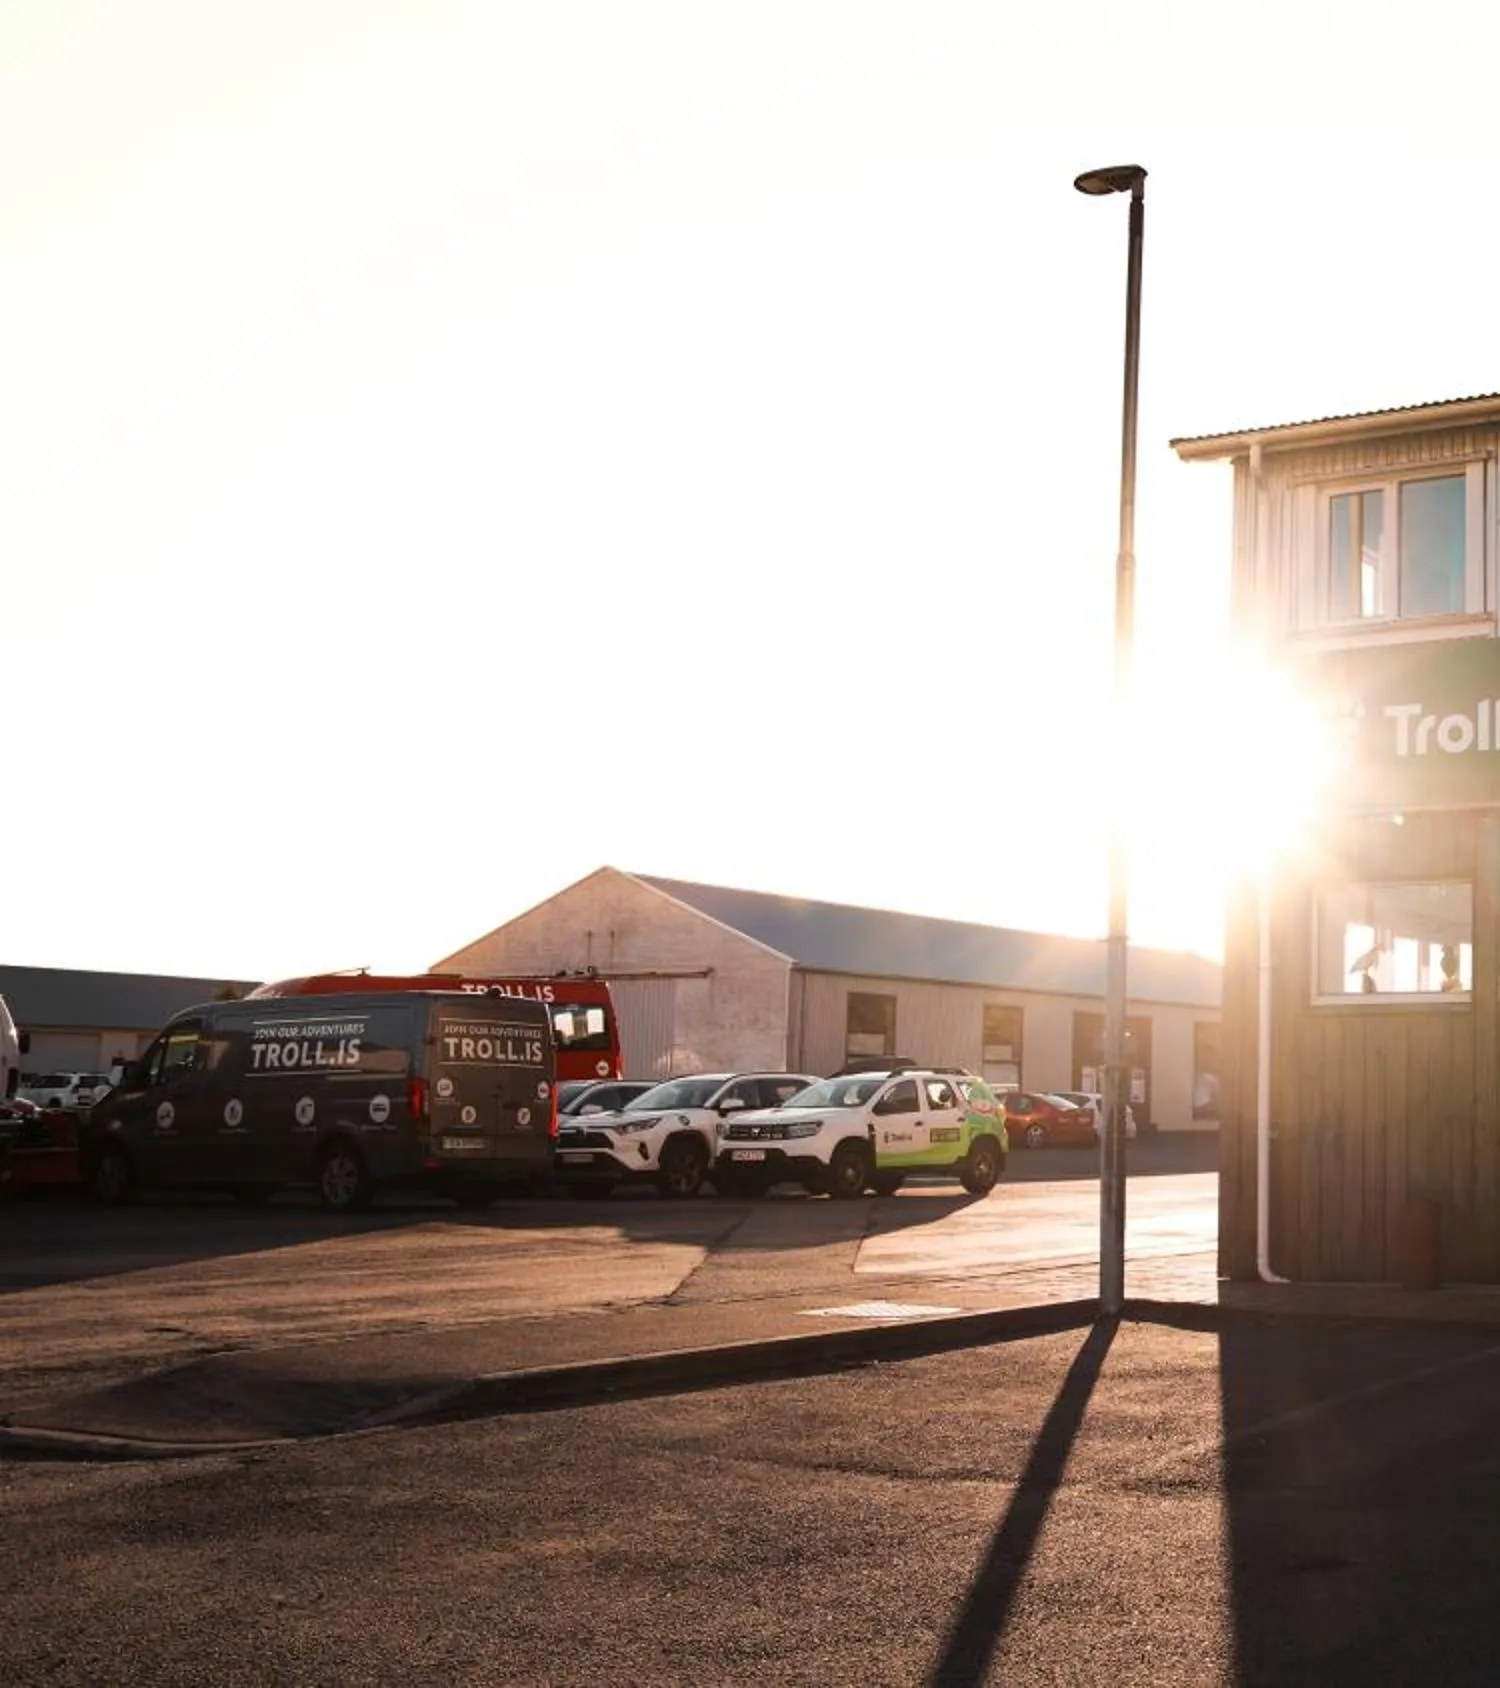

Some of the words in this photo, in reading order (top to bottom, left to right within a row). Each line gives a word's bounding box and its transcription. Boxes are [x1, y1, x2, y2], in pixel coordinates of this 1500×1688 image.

[461, 984, 555, 1002] TRLLIS
[301, 1023, 365, 1037] ADVENTURES
[251, 1039, 361, 1069] TROLL.IS
[443, 1038, 543, 1062] TROLL.IS
